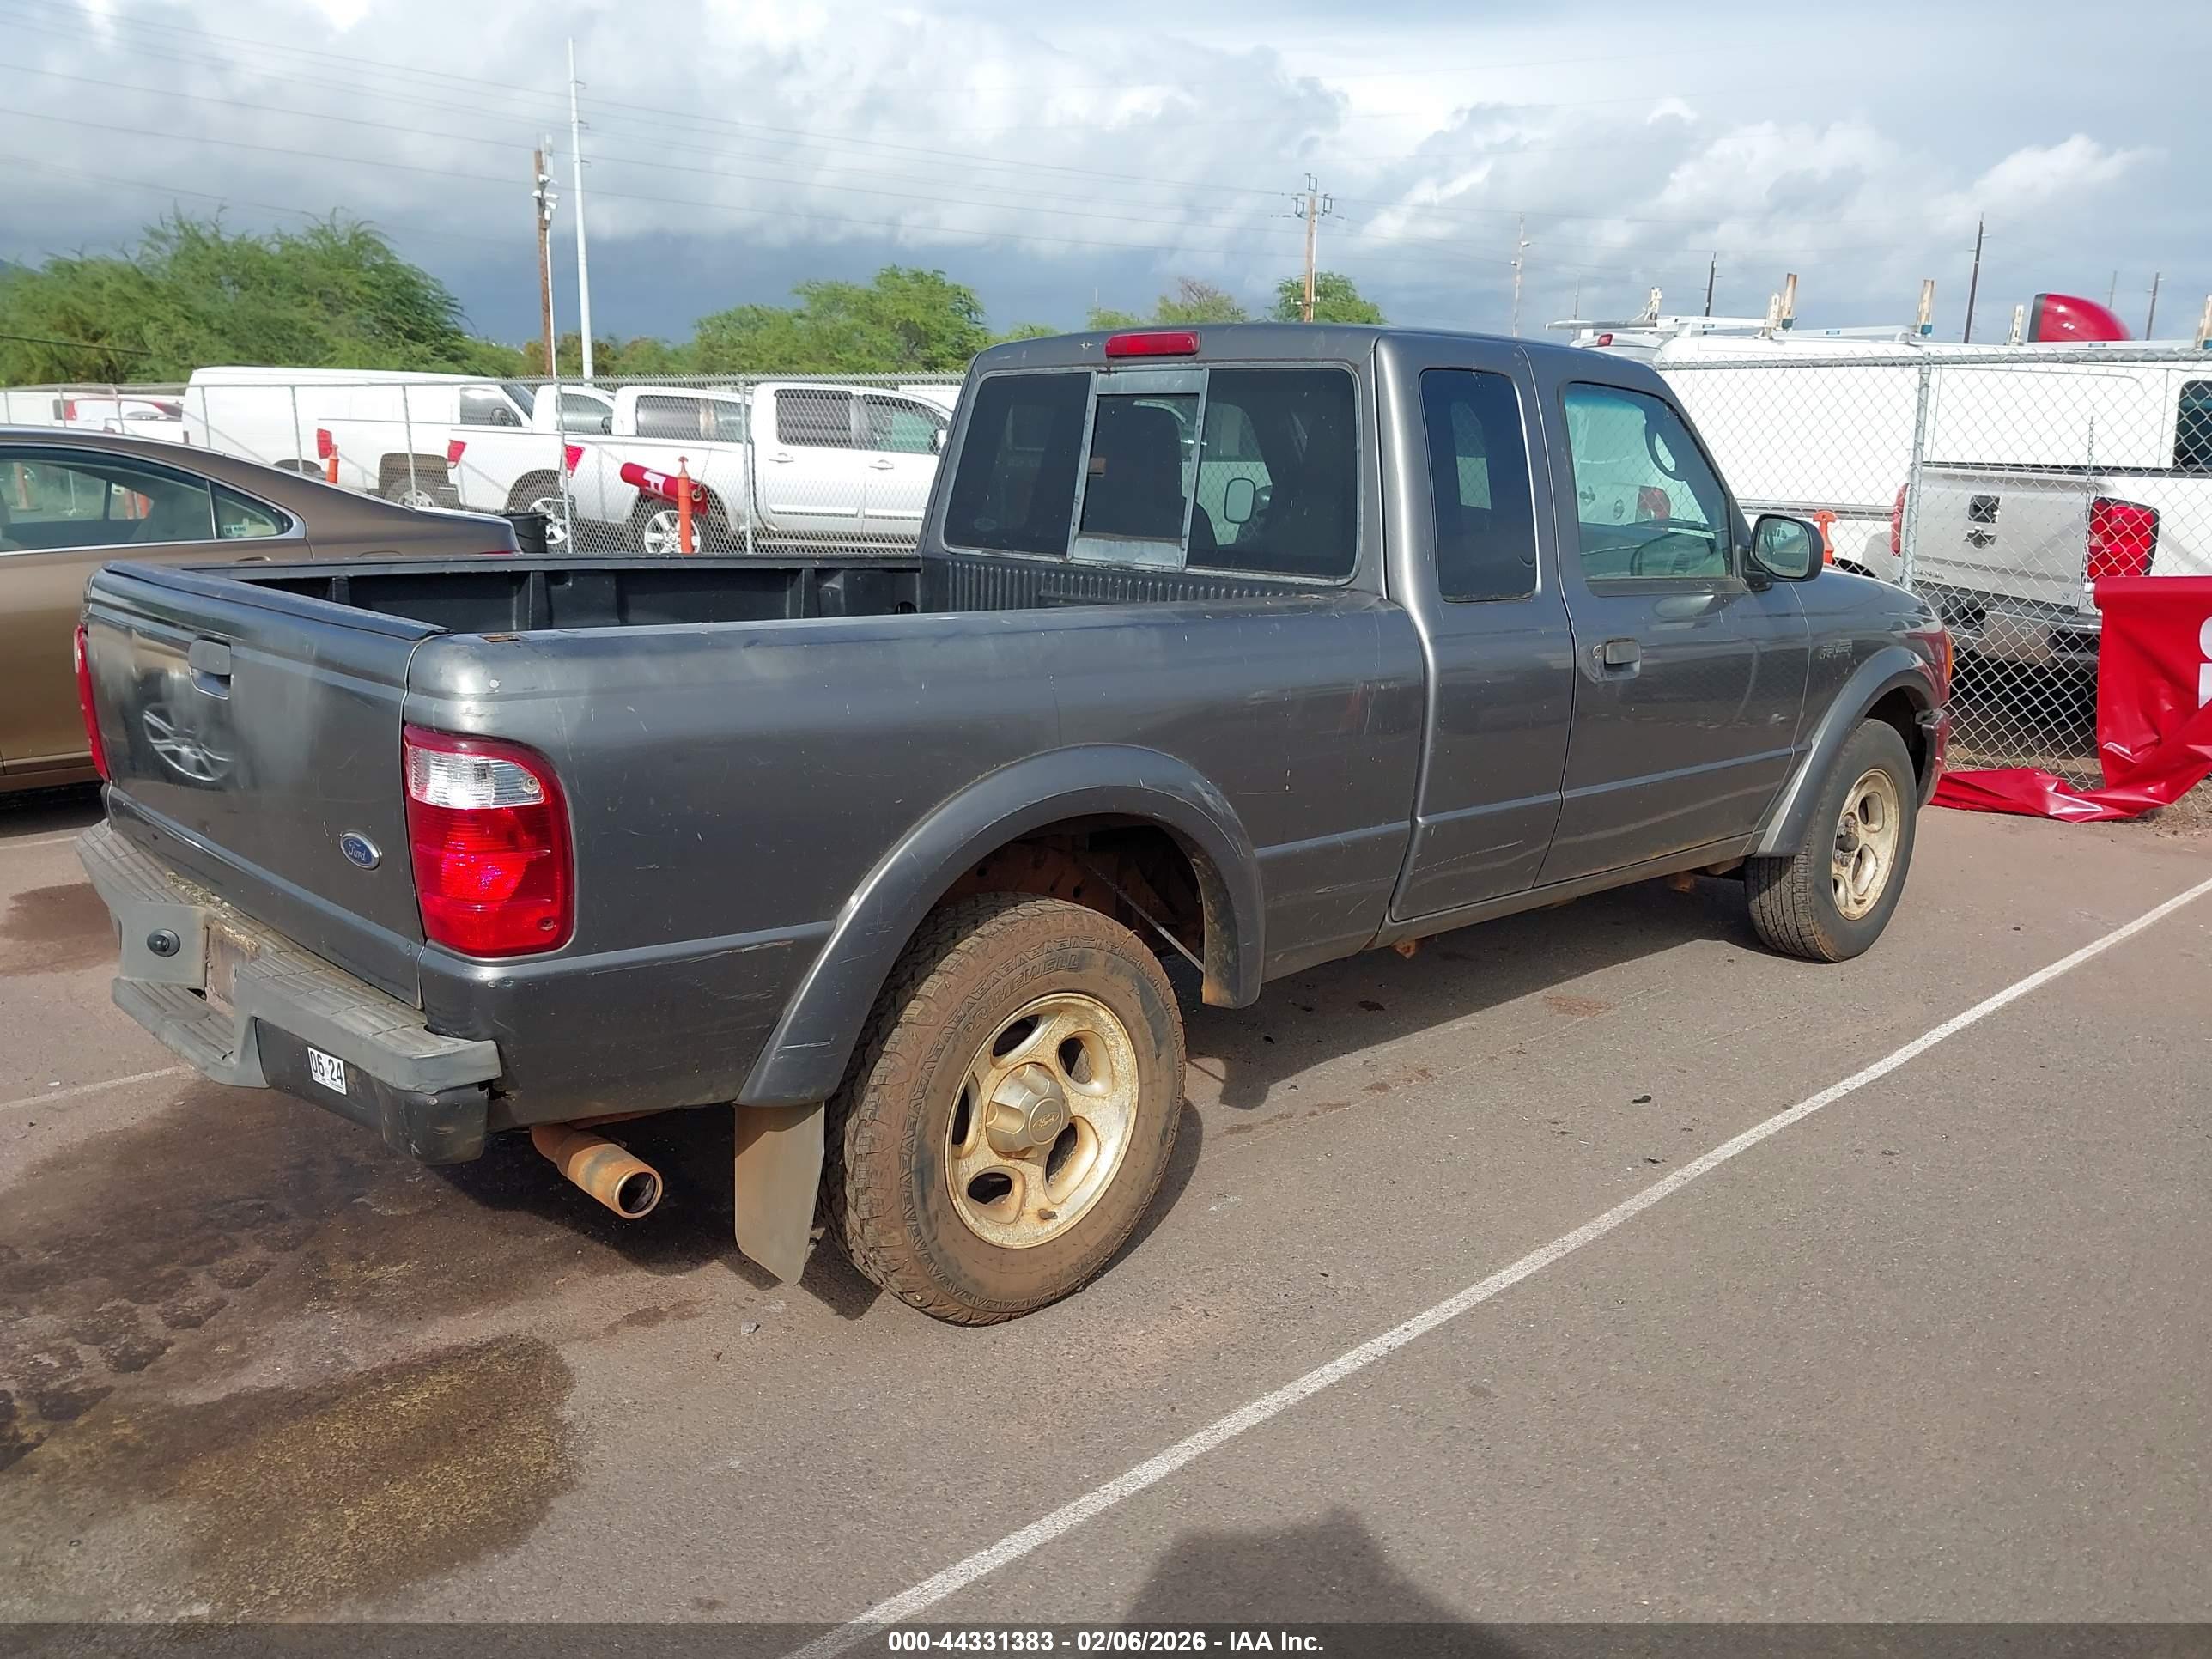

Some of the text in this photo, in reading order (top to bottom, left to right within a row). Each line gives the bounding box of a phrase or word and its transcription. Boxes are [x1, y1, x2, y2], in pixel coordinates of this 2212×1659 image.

[961, 953, 1079, 1043] PRIMEWELL
[310, 1050, 325, 1077] 06
[328, 1059, 343, 1085] 24
